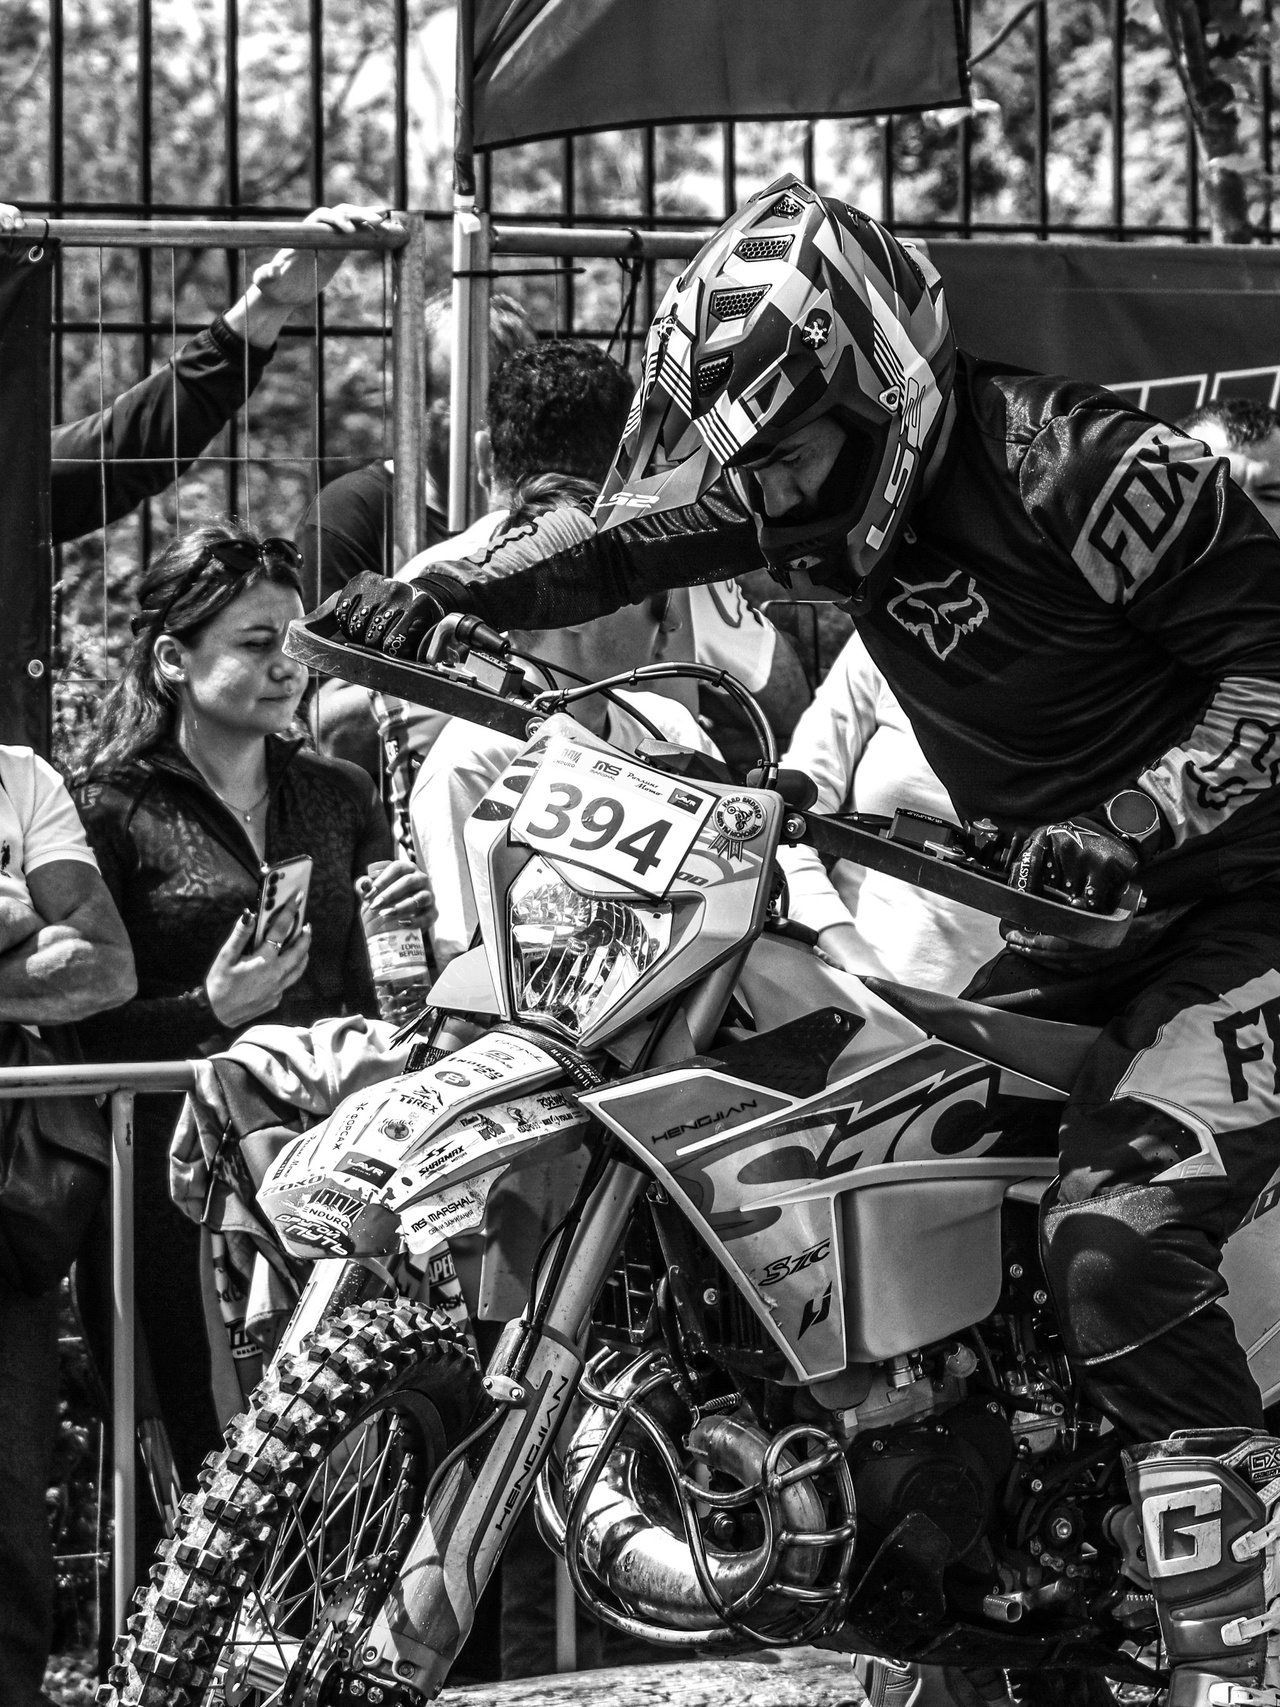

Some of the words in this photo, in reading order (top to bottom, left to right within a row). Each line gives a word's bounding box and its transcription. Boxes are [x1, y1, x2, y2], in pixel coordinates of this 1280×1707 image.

[865, 377, 926, 550] LS2
[1088, 435, 1199, 588] FOX
[526, 782, 674, 877] 394
[347, 1158, 384, 1177] LAVR
[651, 1099, 758, 1144] HENGJIAN
[284, 1224, 349, 1256] ПУТЬ
[427, 1196, 475, 1223] MARSHAL
[495, 1376, 569, 1532] HENGJIAN
[1142, 1484, 1222, 1578] G
